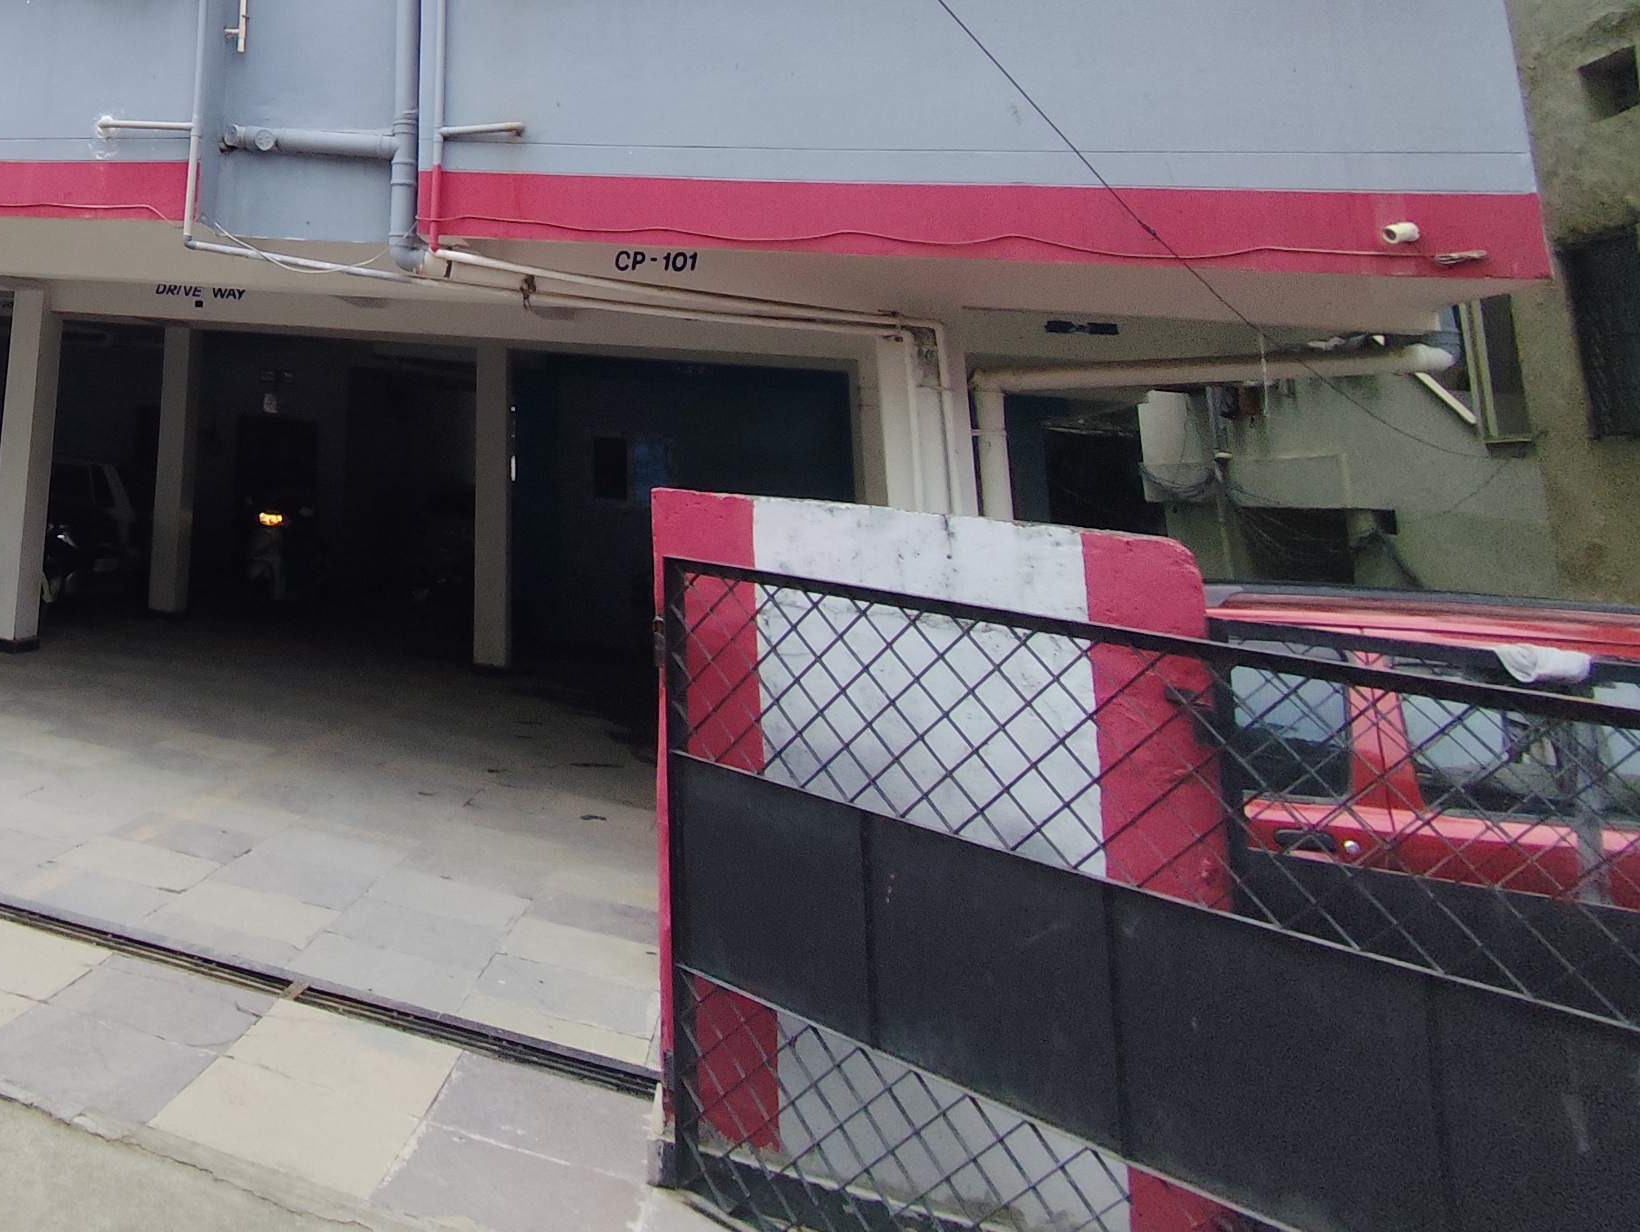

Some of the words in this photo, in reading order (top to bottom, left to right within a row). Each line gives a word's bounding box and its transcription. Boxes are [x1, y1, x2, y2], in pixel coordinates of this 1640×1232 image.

[615, 250, 698, 272] CP-101
[155, 283, 202, 297] DRIVE
[212, 287, 246, 300] WAY
